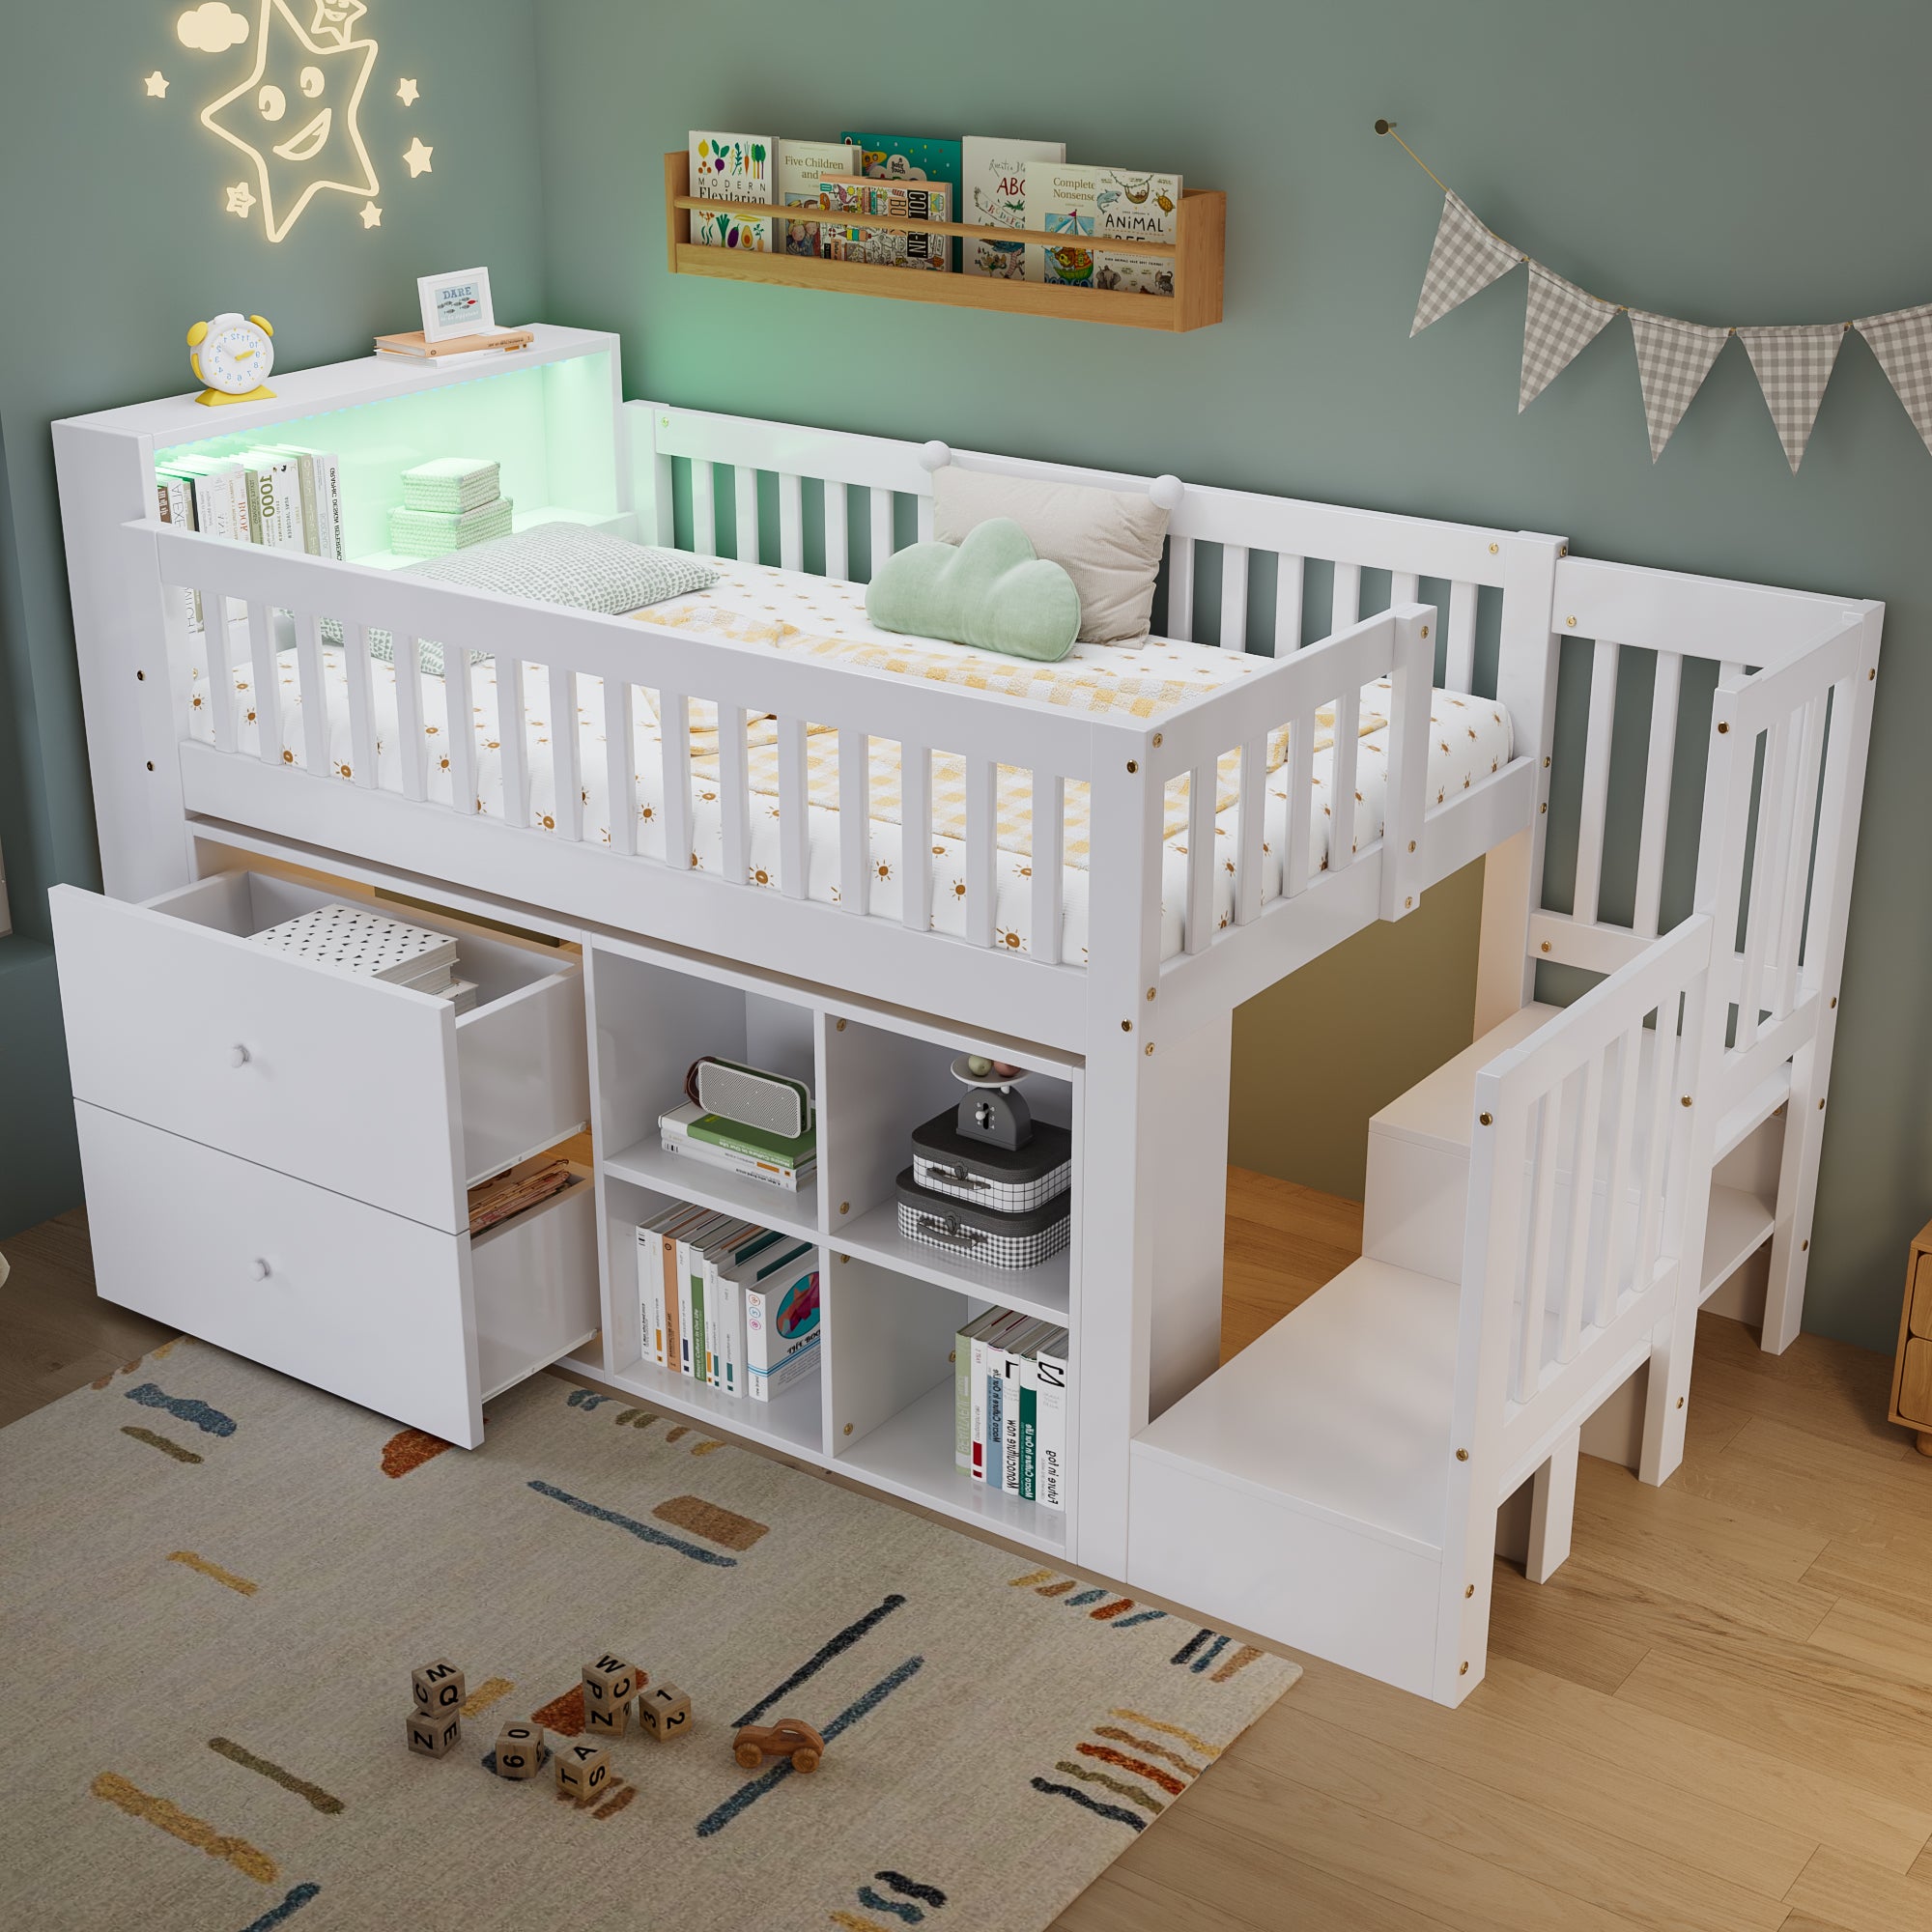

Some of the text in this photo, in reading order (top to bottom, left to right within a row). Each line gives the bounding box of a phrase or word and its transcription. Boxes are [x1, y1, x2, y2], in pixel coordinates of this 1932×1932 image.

[785, 156, 843, 169] Five Children
[802, 170, 818, 180] and
[698, 178, 766, 191] MODERN
[442, 286, 471, 299] DARE
[440, 1685, 459, 1706] Q
[587, 1679, 602, 1699] P
[613, 1678, 630, 1698] C
[656, 1690, 672, 1701] 1
[643, 1711, 657, 1728] 3
[667, 1712, 685, 1729] 2
[574, 1747, 598, 1761] A
[561, 1768, 579, 1785] T
[589, 1766, 606, 1786] S
